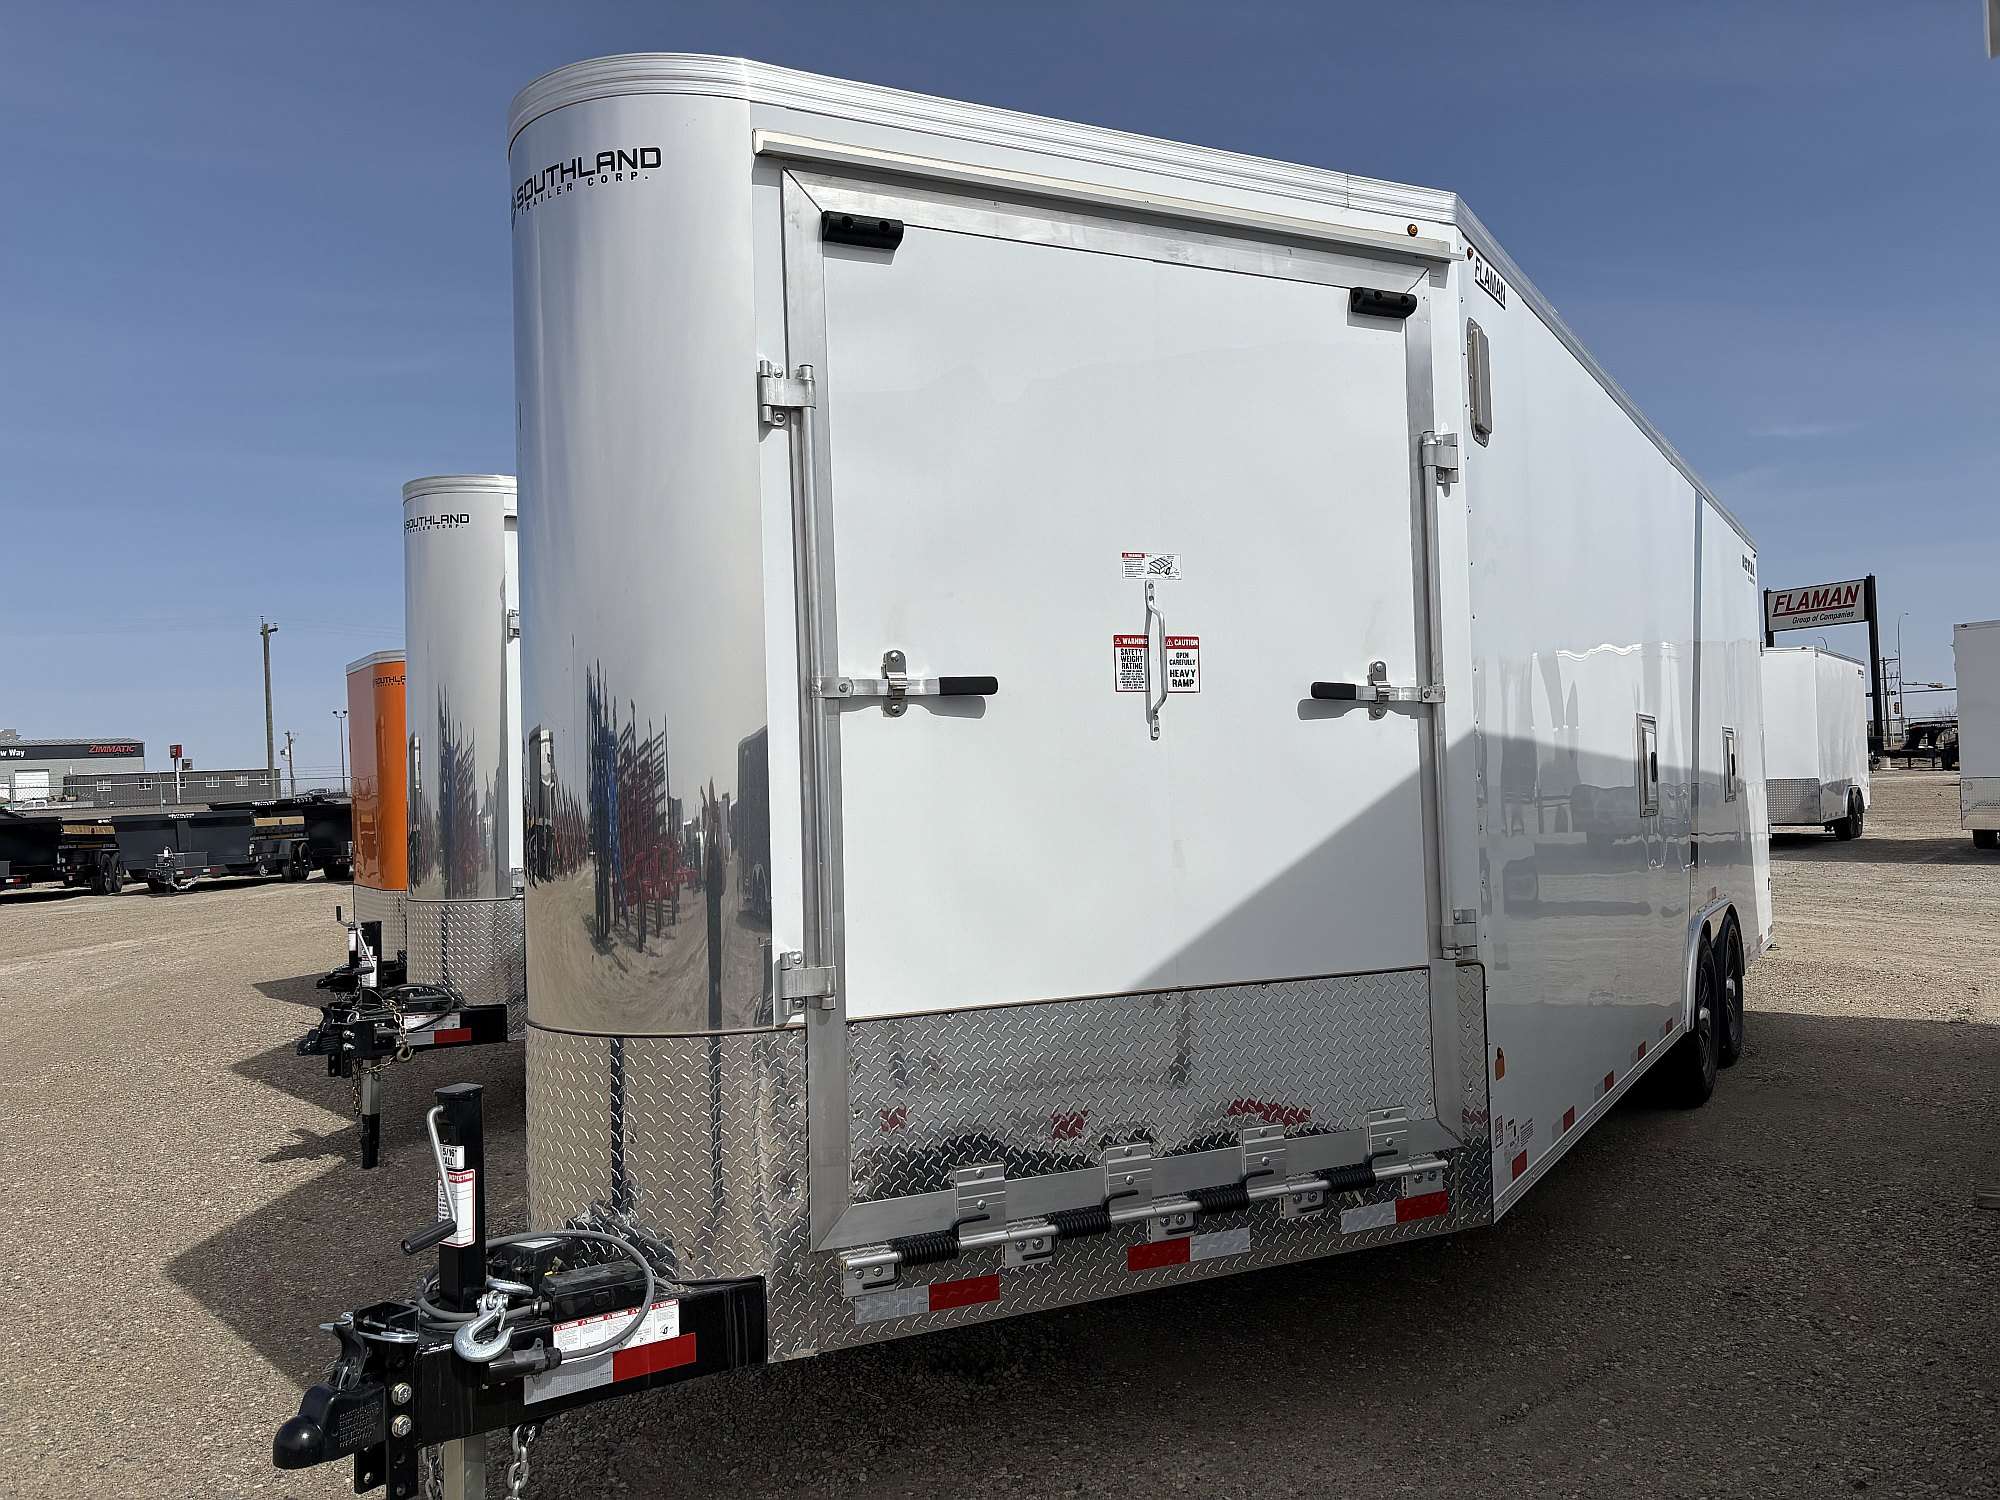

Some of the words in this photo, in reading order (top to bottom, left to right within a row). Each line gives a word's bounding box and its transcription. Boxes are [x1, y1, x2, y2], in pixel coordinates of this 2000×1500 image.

[516, 147, 662, 209] SOUTHLAND
[521, 182, 573, 215] TRAILER
[587, 171, 650, 187] CORP.
[1475, 255, 1506, 306] FLAMAN
[1773, 584, 1861, 614] FLAMAN
[1792, 615, 1811, 625] Group
[1812, 614, 1819, 622] of
[1820, 610, 1855, 622] Companies
[1174, 638, 1199, 647] CAUTION
[1120, 648, 1143, 656] SAFETY
[1120, 655, 1144, 663] WEIGHT
[1121, 662, 1143, 670] RATING
[1169, 669, 1196, 678] HEAVY
[1172, 678, 1195, 688] RAMP
[8, 748, 26, 758] Way
[88, 744, 137, 754] ZIMMATIC
